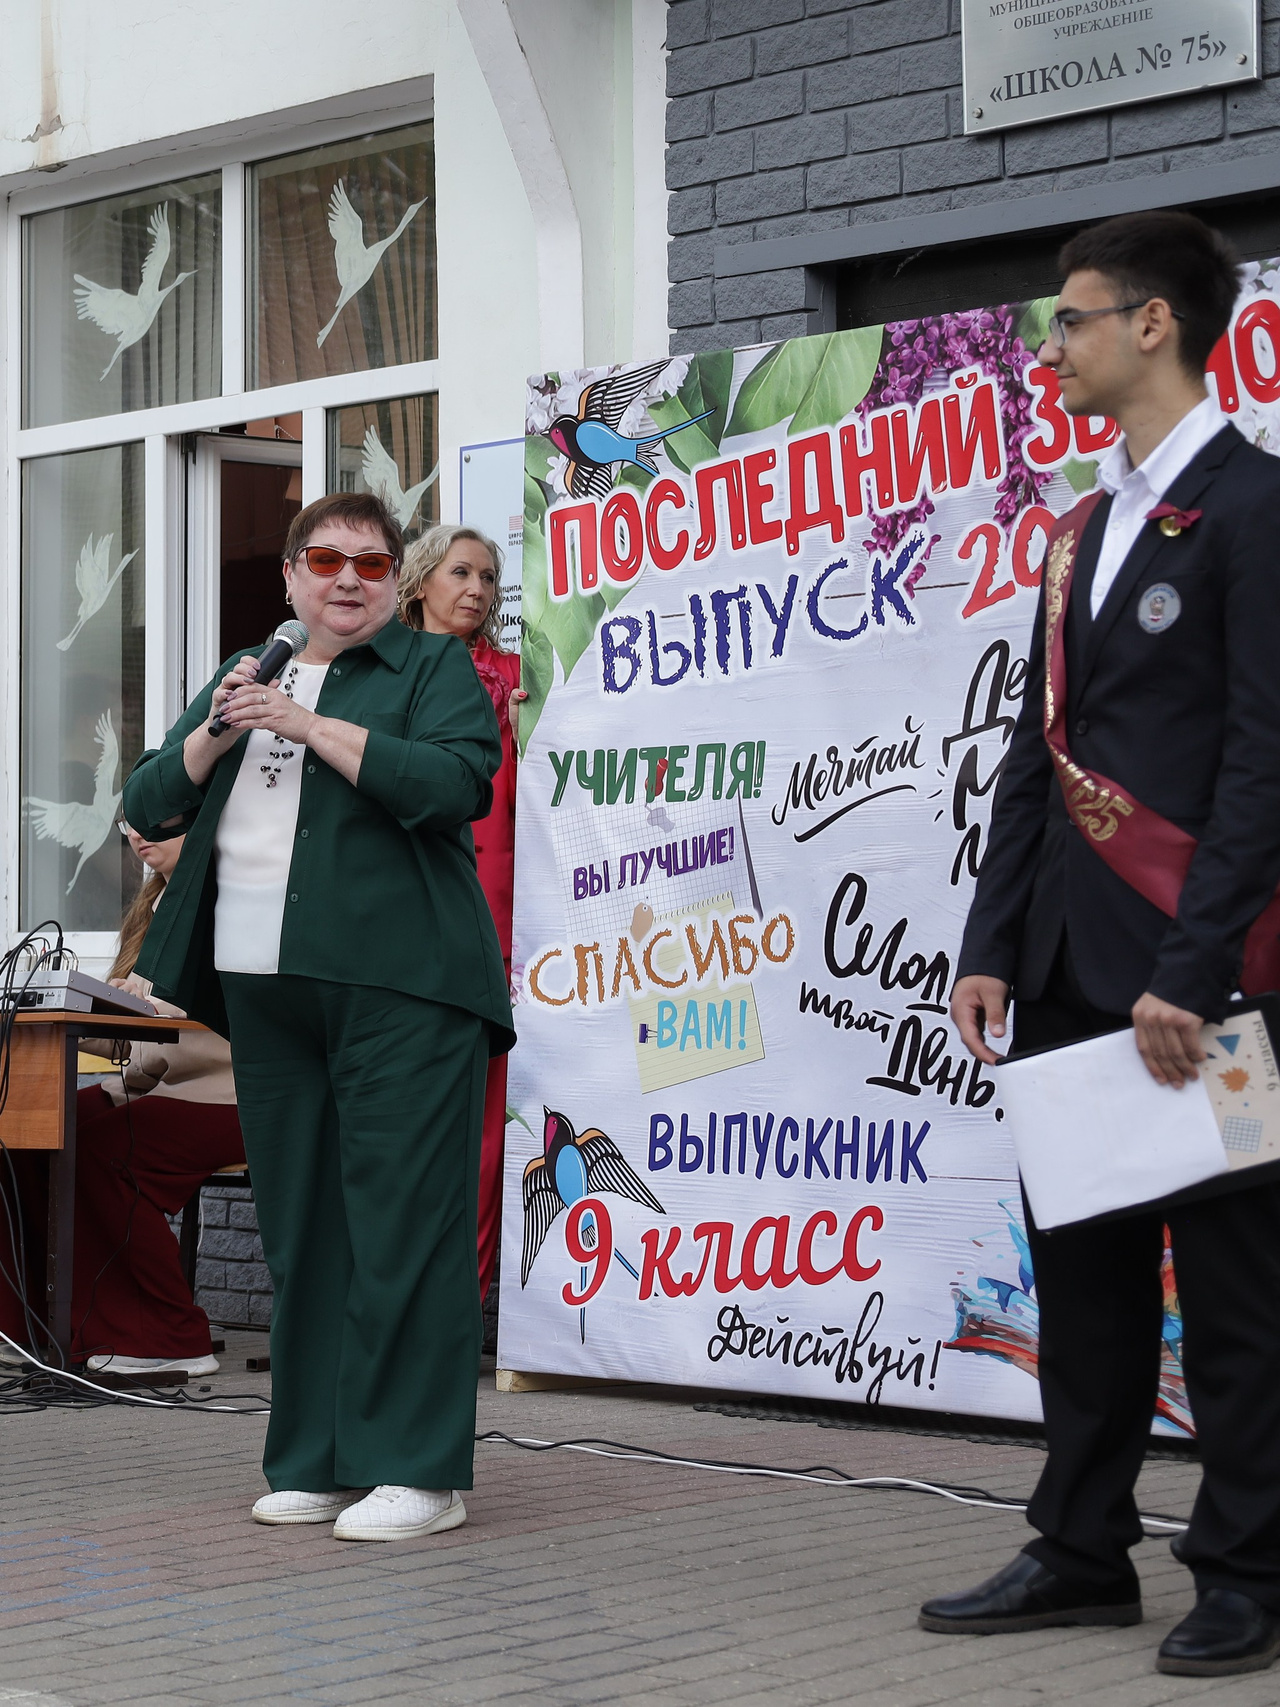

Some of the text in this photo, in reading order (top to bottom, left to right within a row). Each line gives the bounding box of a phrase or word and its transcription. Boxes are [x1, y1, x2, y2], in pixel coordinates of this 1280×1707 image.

[1053, 8, 1154, 40] УЧРЕЖДЕНИЕ
[989, 32, 1227, 103] «ШКОЛА № 75»
[549, 372, 1002, 597] ПОСЛЕДНИЙ
[600, 531, 925, 694] ВЫПУСК
[958, 497, 1075, 619] 20
[548, 741, 766, 807] УЧИТЕЛЯ!
[772, 715, 926, 826] Мечтай
[573, 826, 734, 901] ВЫ ЛУЧШИЕ!
[529, 913, 795, 1006] СПАСИБО
[824, 872, 950, 1014] Сегод
[657, 999, 747, 1051] ВАМ!
[800, 981, 895, 1043] твой
[648, 1111, 931, 1184] ВЫПУСКНИК
[562, 1199, 884, 1305] 9 класс
[708, 1291, 942, 1404] Действуй!
